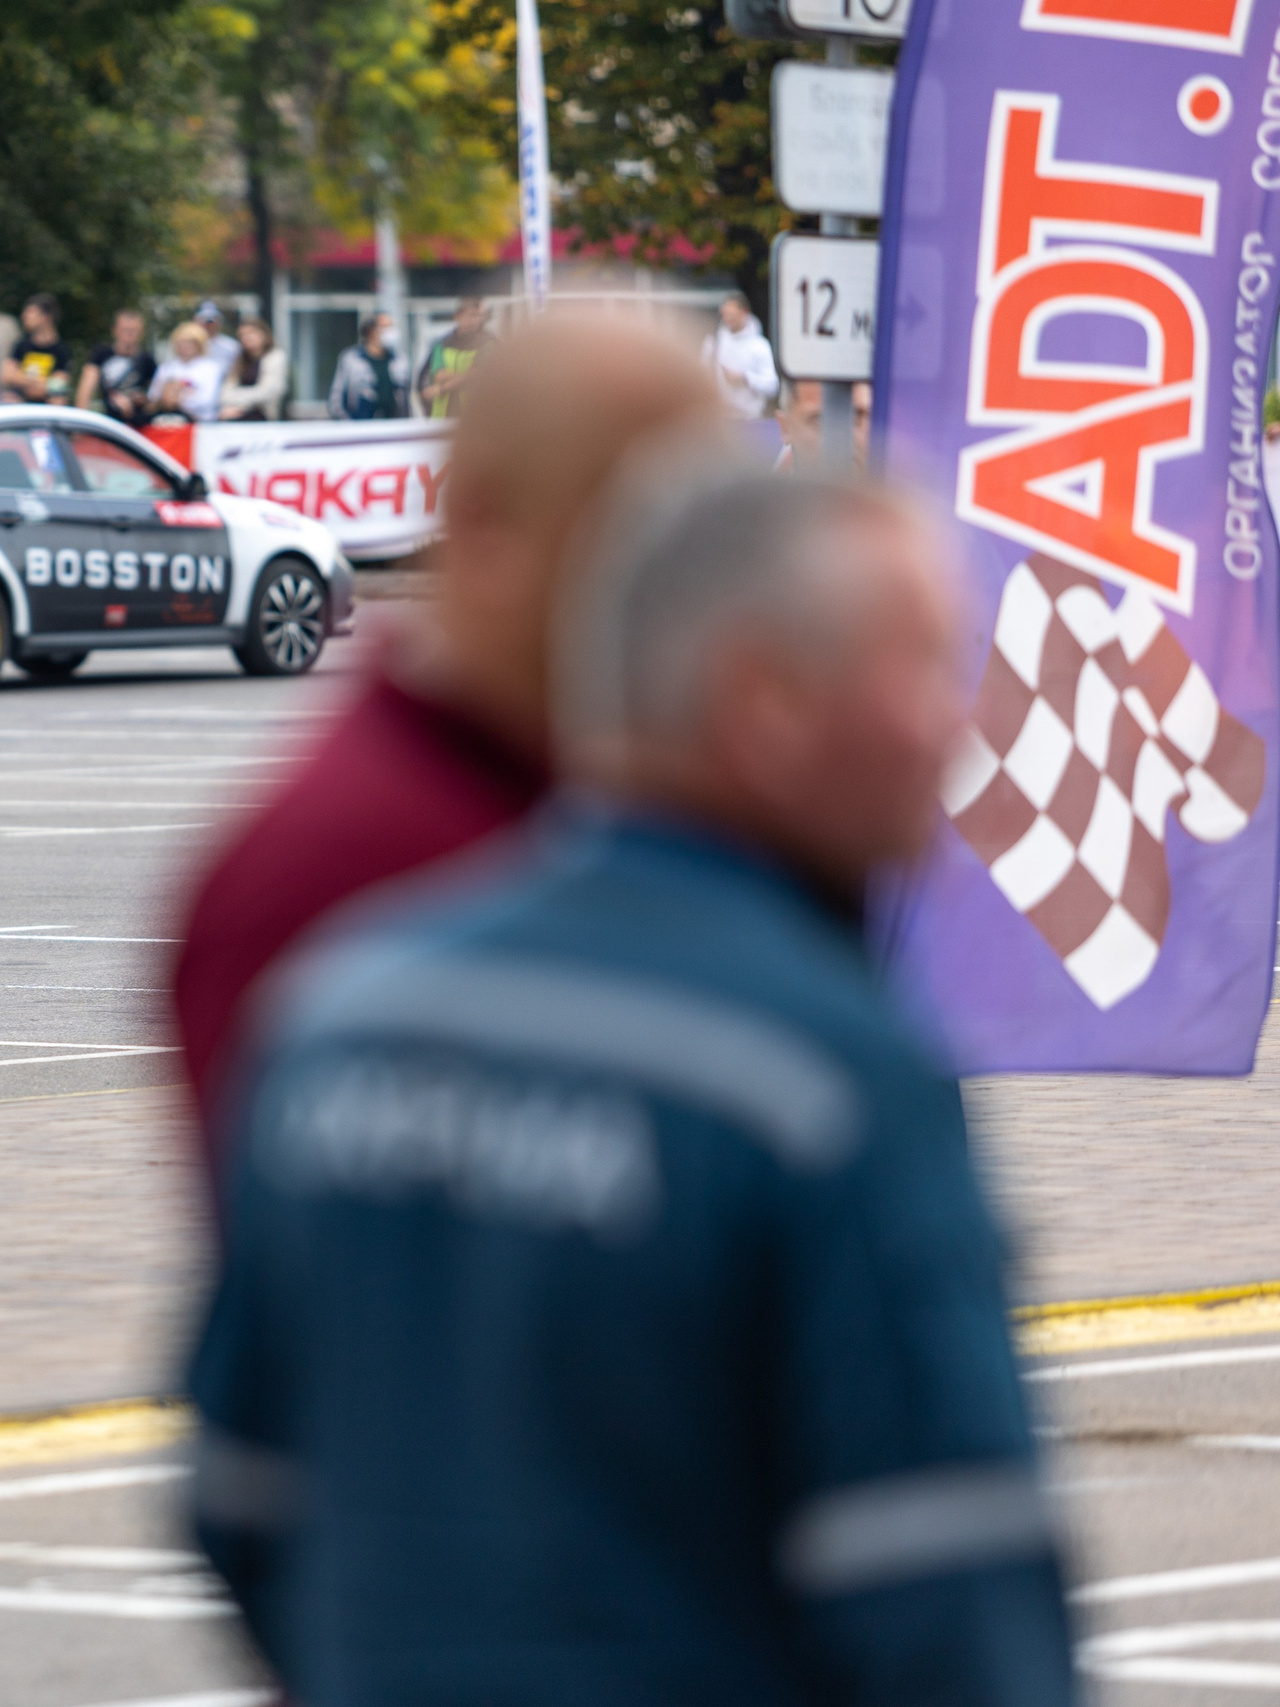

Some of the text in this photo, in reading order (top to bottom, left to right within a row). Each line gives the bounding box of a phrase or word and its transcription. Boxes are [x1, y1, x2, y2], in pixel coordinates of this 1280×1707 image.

[795, 277, 838, 337] 12
[955, 0, 1258, 618] ADT.
[24, 546, 226, 594] BOSSTON
